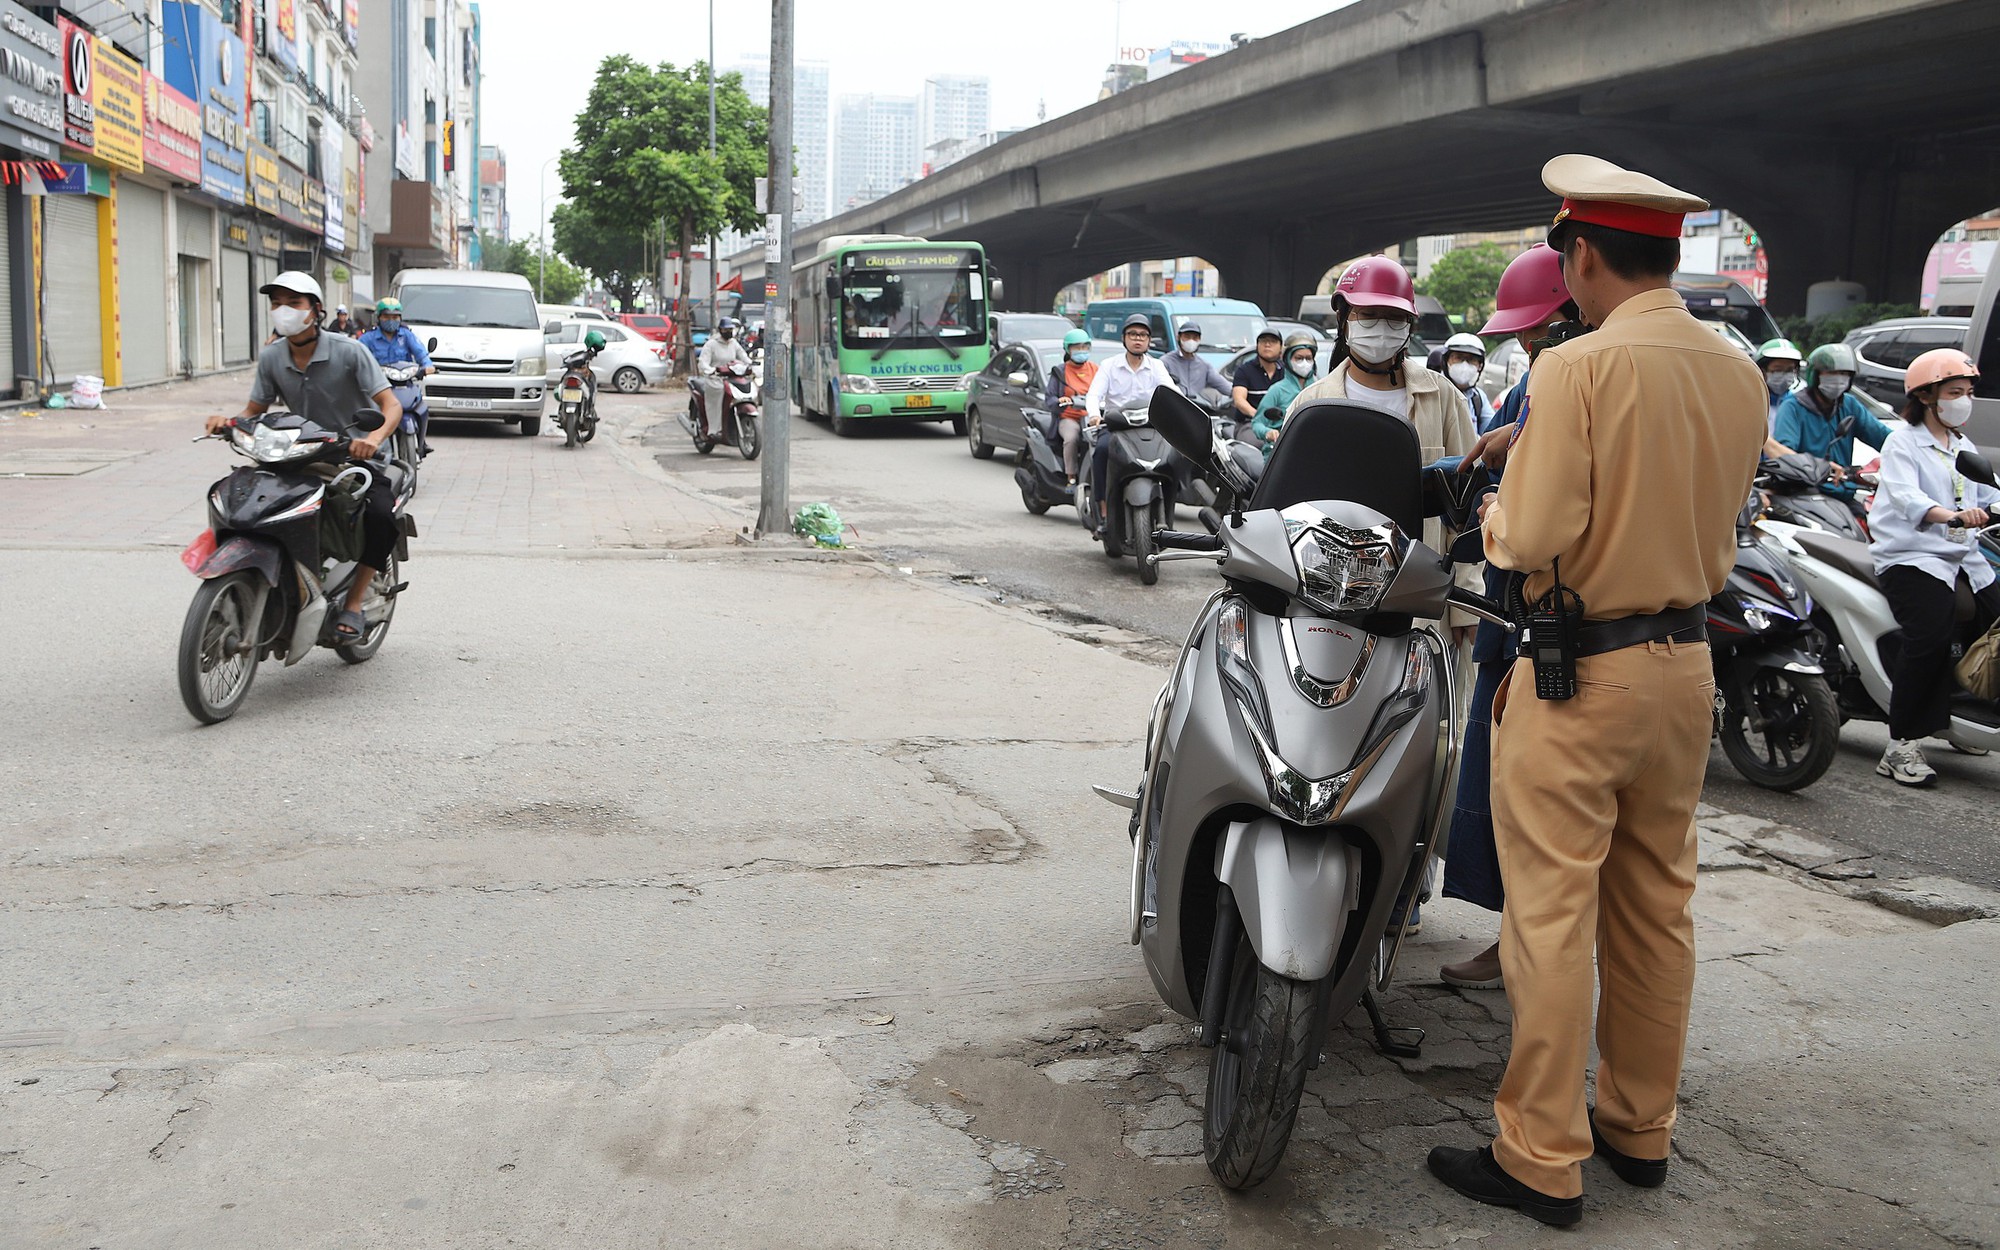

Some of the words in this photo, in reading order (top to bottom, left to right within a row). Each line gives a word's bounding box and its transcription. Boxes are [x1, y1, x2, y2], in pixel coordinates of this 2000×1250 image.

[871, 363, 893, 375] BẢO
[896, 362, 917, 374] YẾN
[920, 364, 940, 374] CNG
[943, 363, 963, 373] BUS
[1307, 626, 1353, 641] HONDA
